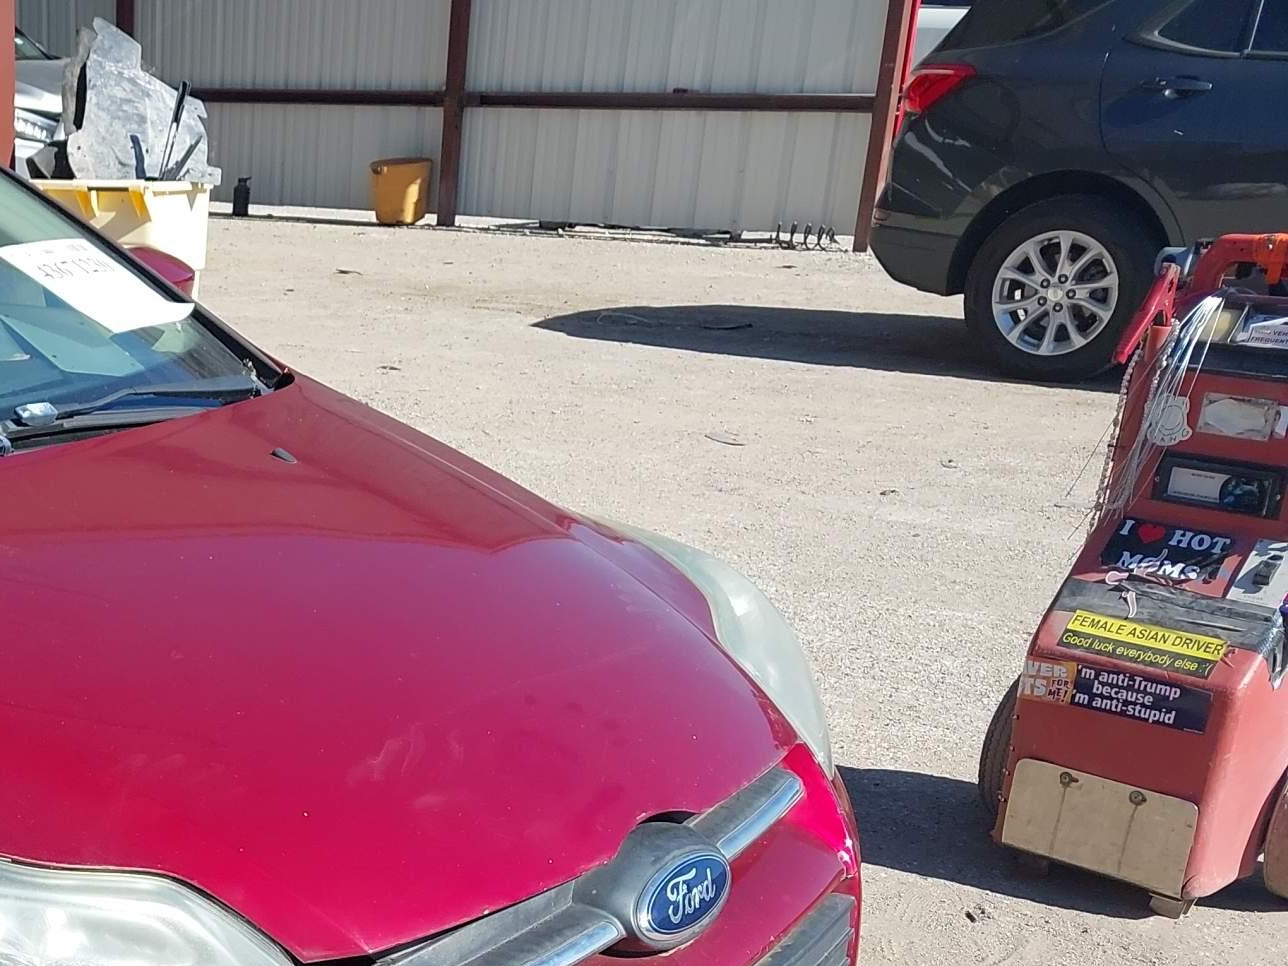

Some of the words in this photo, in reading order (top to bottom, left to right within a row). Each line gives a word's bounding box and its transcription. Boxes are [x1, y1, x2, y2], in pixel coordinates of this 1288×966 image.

[1120, 519, 1136, 535] I
[1168, 529, 1231, 553] HOT
[1116, 551, 1201, 579] MOMS
[1071, 614, 1125, 635] FEMALE
[1127, 626, 1171, 644] ASIAN
[1172, 636, 1224, 656] DRIVER
[1062, 632, 1091, 648] Good
[1092, 638, 1114, 653] luck
[1116, 646, 1173, 667] everybody
[1174, 656, 1198, 671] else
[1093, 680, 1154, 705] because
[1098, 671, 1181, 700] anti-Trump
[1092, 697, 1176, 724] anti-stupid
[666, 867, 716, 925] Ford
